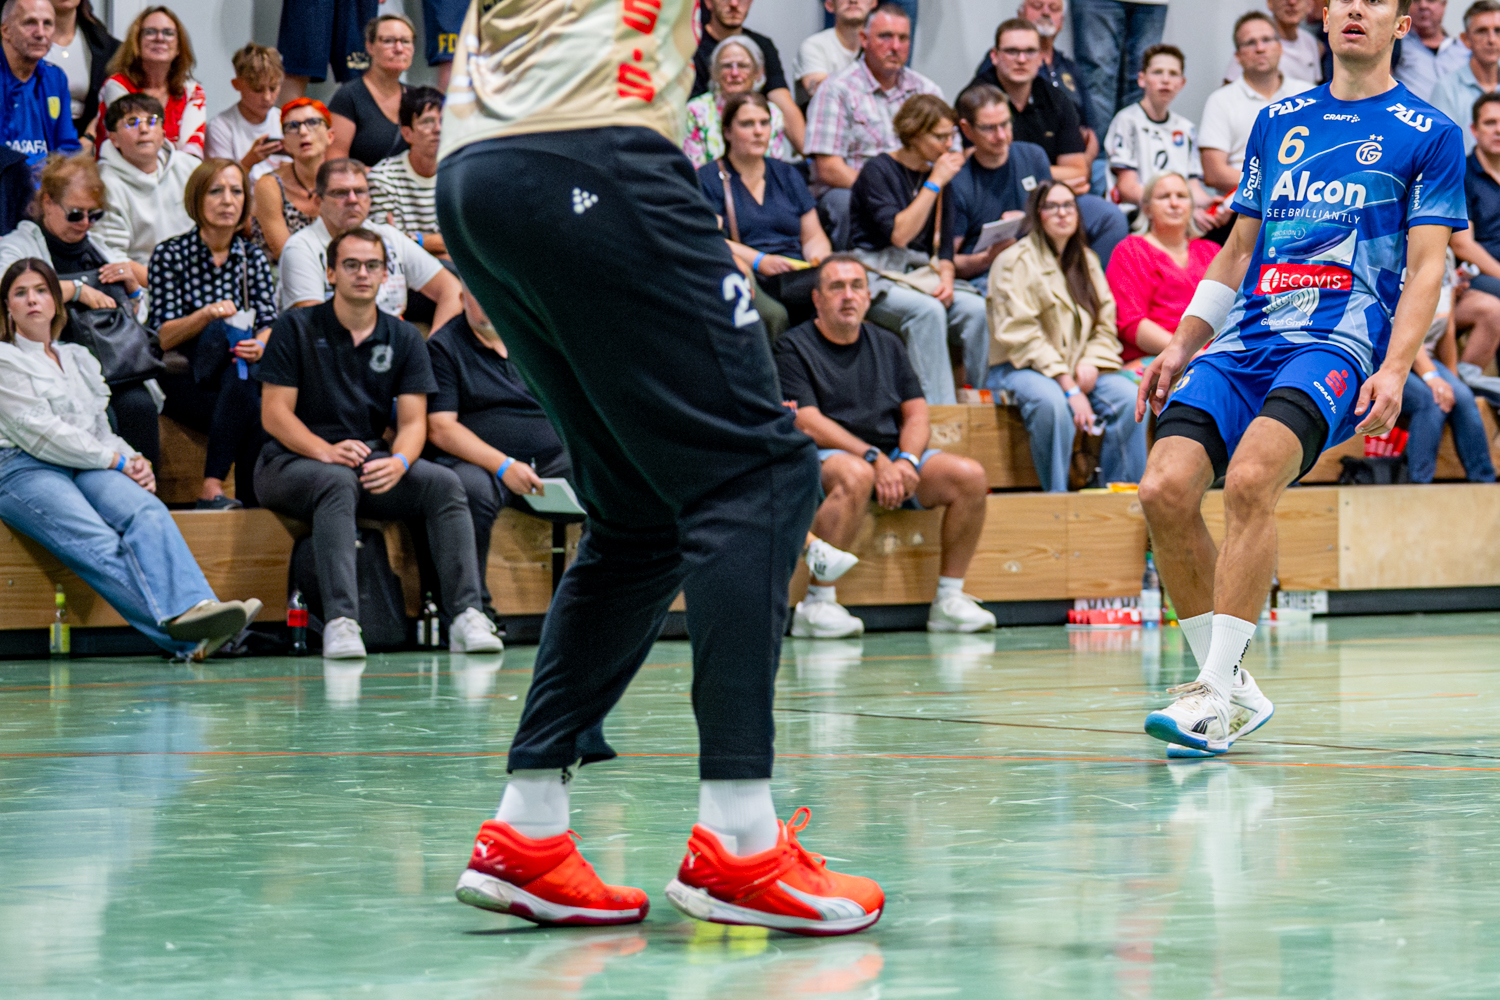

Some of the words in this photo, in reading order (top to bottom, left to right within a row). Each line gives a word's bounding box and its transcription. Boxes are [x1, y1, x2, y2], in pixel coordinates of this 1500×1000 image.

[1269, 98, 1317, 118] PASS
[1323, 113, 1352, 122] CRAFT
[1386, 103, 1433, 132] PASS
[1277, 126, 1310, 165] 6
[1270, 170, 1367, 209] Alcon
[1266, 207, 1286, 218] SEE
[1288, 207, 1361, 225] BRILLIANTLY
[1280, 273, 1342, 289] ECOVIS
[1313, 381, 1335, 407] CRAFT
